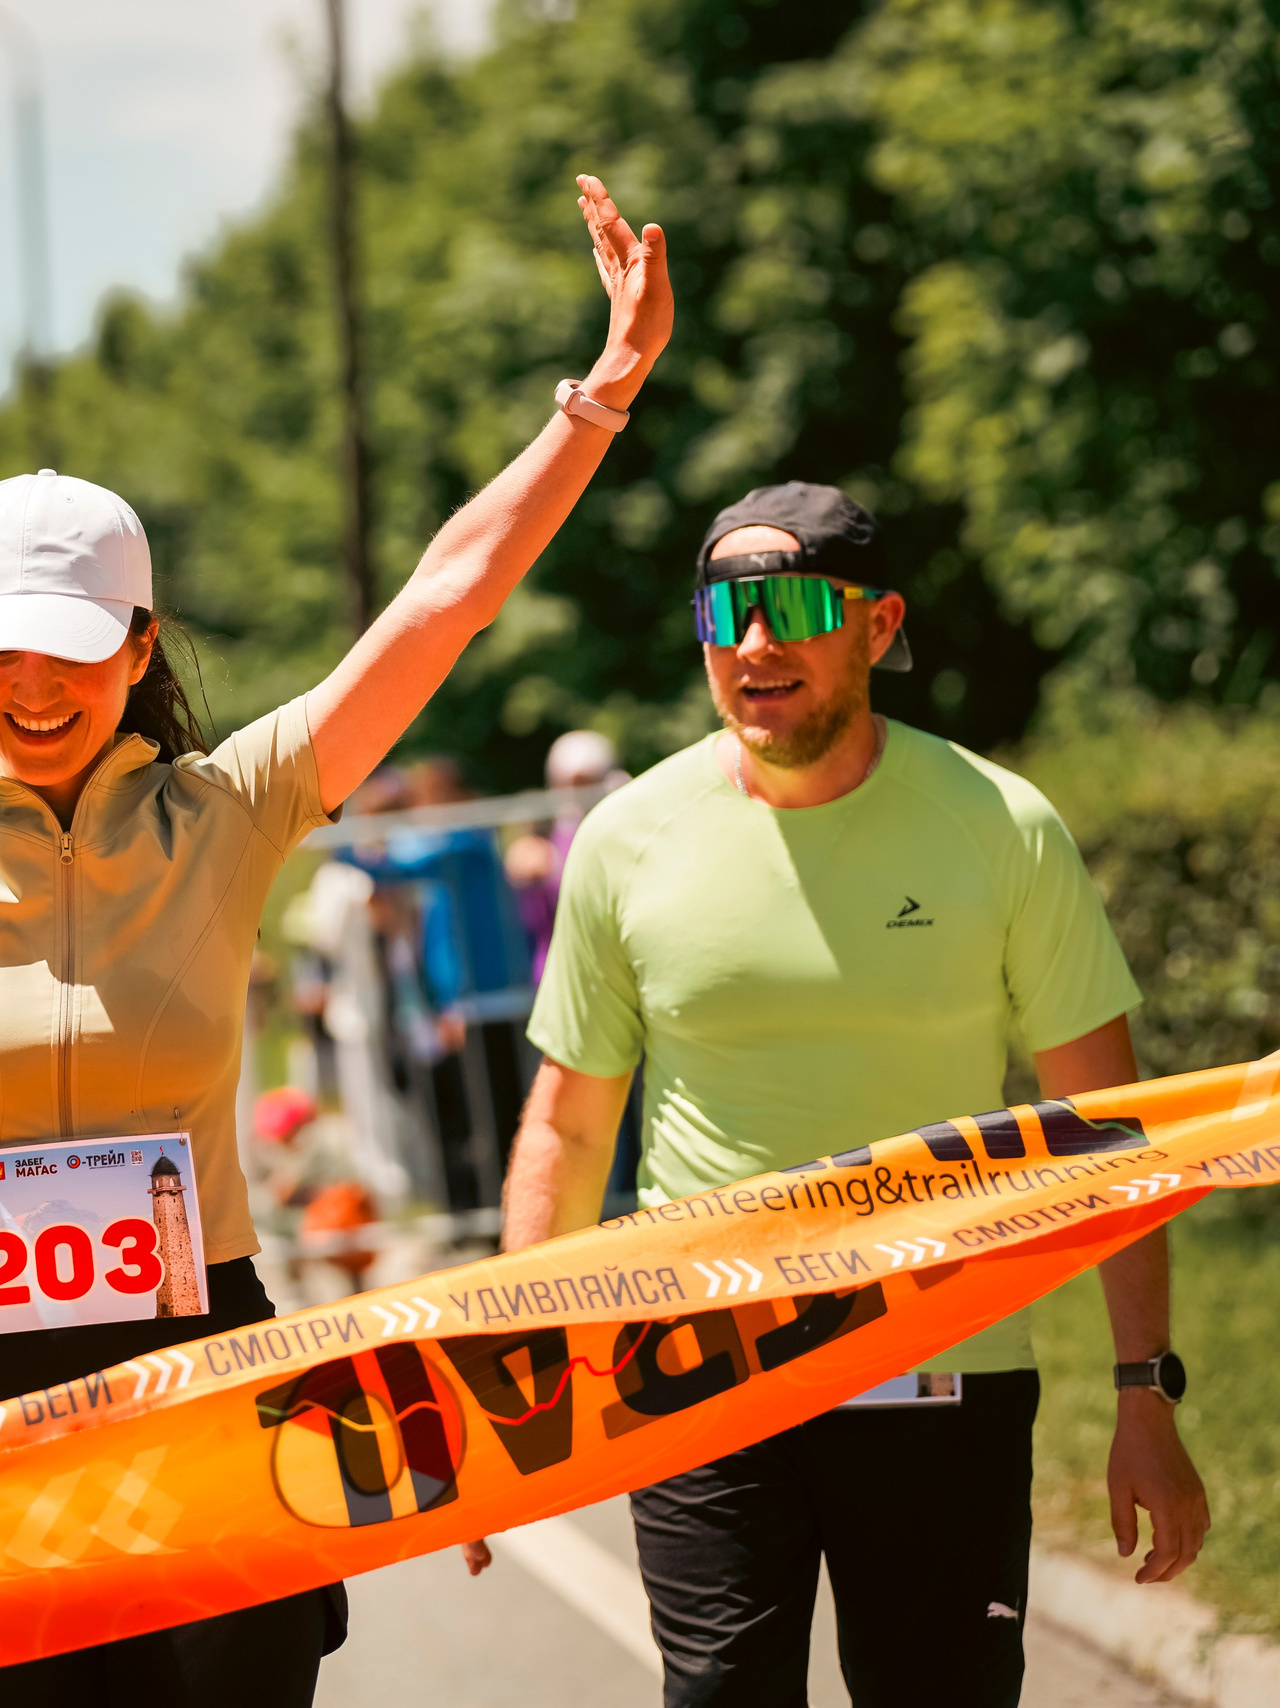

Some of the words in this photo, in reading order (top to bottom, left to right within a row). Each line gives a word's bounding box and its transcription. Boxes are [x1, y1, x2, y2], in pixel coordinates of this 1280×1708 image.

[15, 1157, 45, 1167] ЗАБЕГ
[16, 1164, 58, 1178] МАГАС
[18, 1369, 114, 1426] БЕГИ
[204, 1312, 366, 1377] СМОТРИ
[448, 1265, 687, 1325] УДИВЛЯЙСЯ
[773, 1248, 873, 1286] БЕГИ
[952, 1193, 1112, 1248] СМОТРИ
